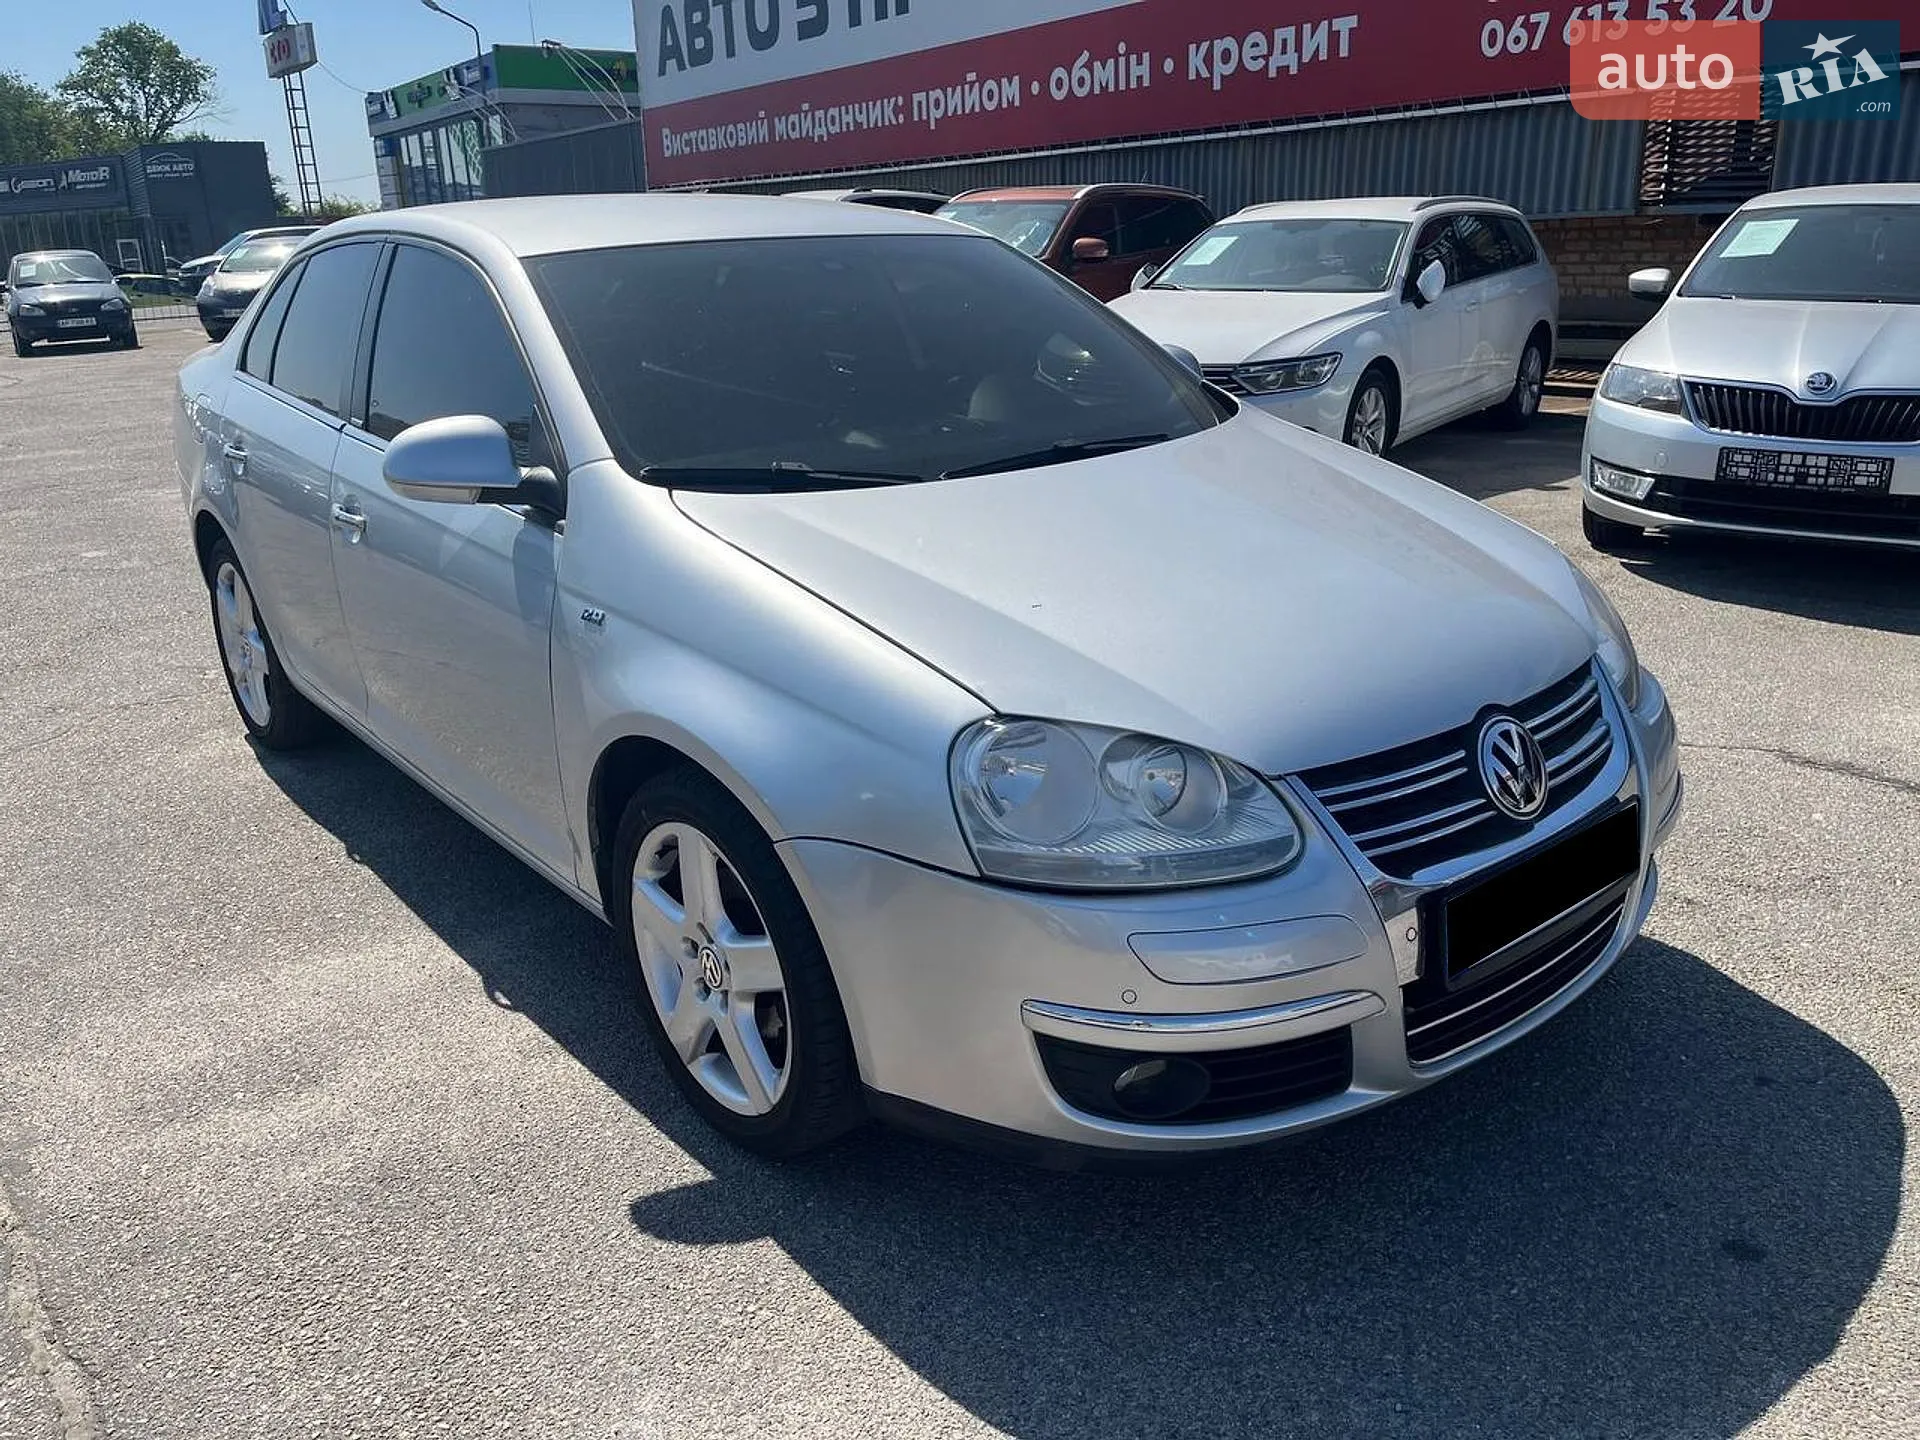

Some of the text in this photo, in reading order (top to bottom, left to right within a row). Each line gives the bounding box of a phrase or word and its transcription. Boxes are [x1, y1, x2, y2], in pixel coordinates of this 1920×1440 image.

[657, 0, 780, 77] АВТО
[1480, 11, 1550, 57] 067
[1562, 1, 1630, 46] 613
[662, 14, 1359, 157] Виставковий майданчик: прийом обмін кредит
